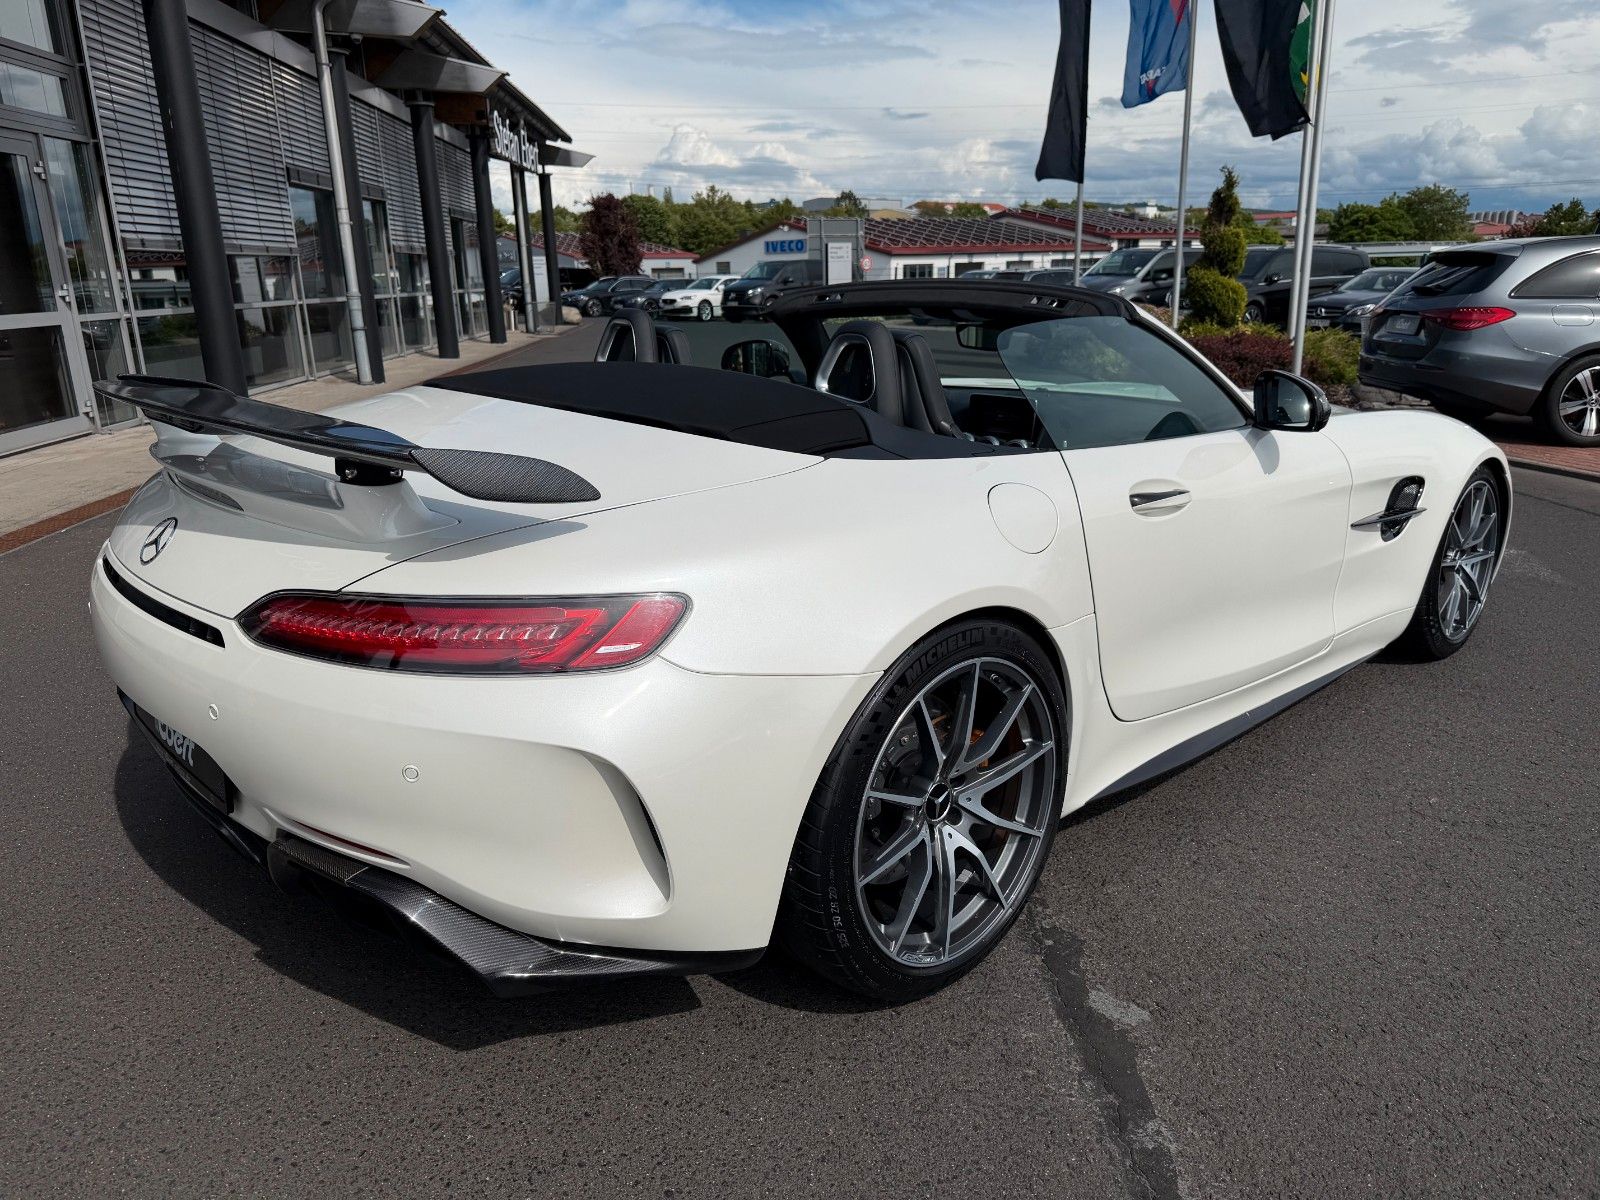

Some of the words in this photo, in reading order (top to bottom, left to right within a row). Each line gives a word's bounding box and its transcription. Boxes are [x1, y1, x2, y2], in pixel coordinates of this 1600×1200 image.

[493, 110, 520, 164] Stefan
[521, 128, 539, 172] Ebert
[766, 239, 804, 253] IVECO
[904, 626, 985, 688] MICHELIN
